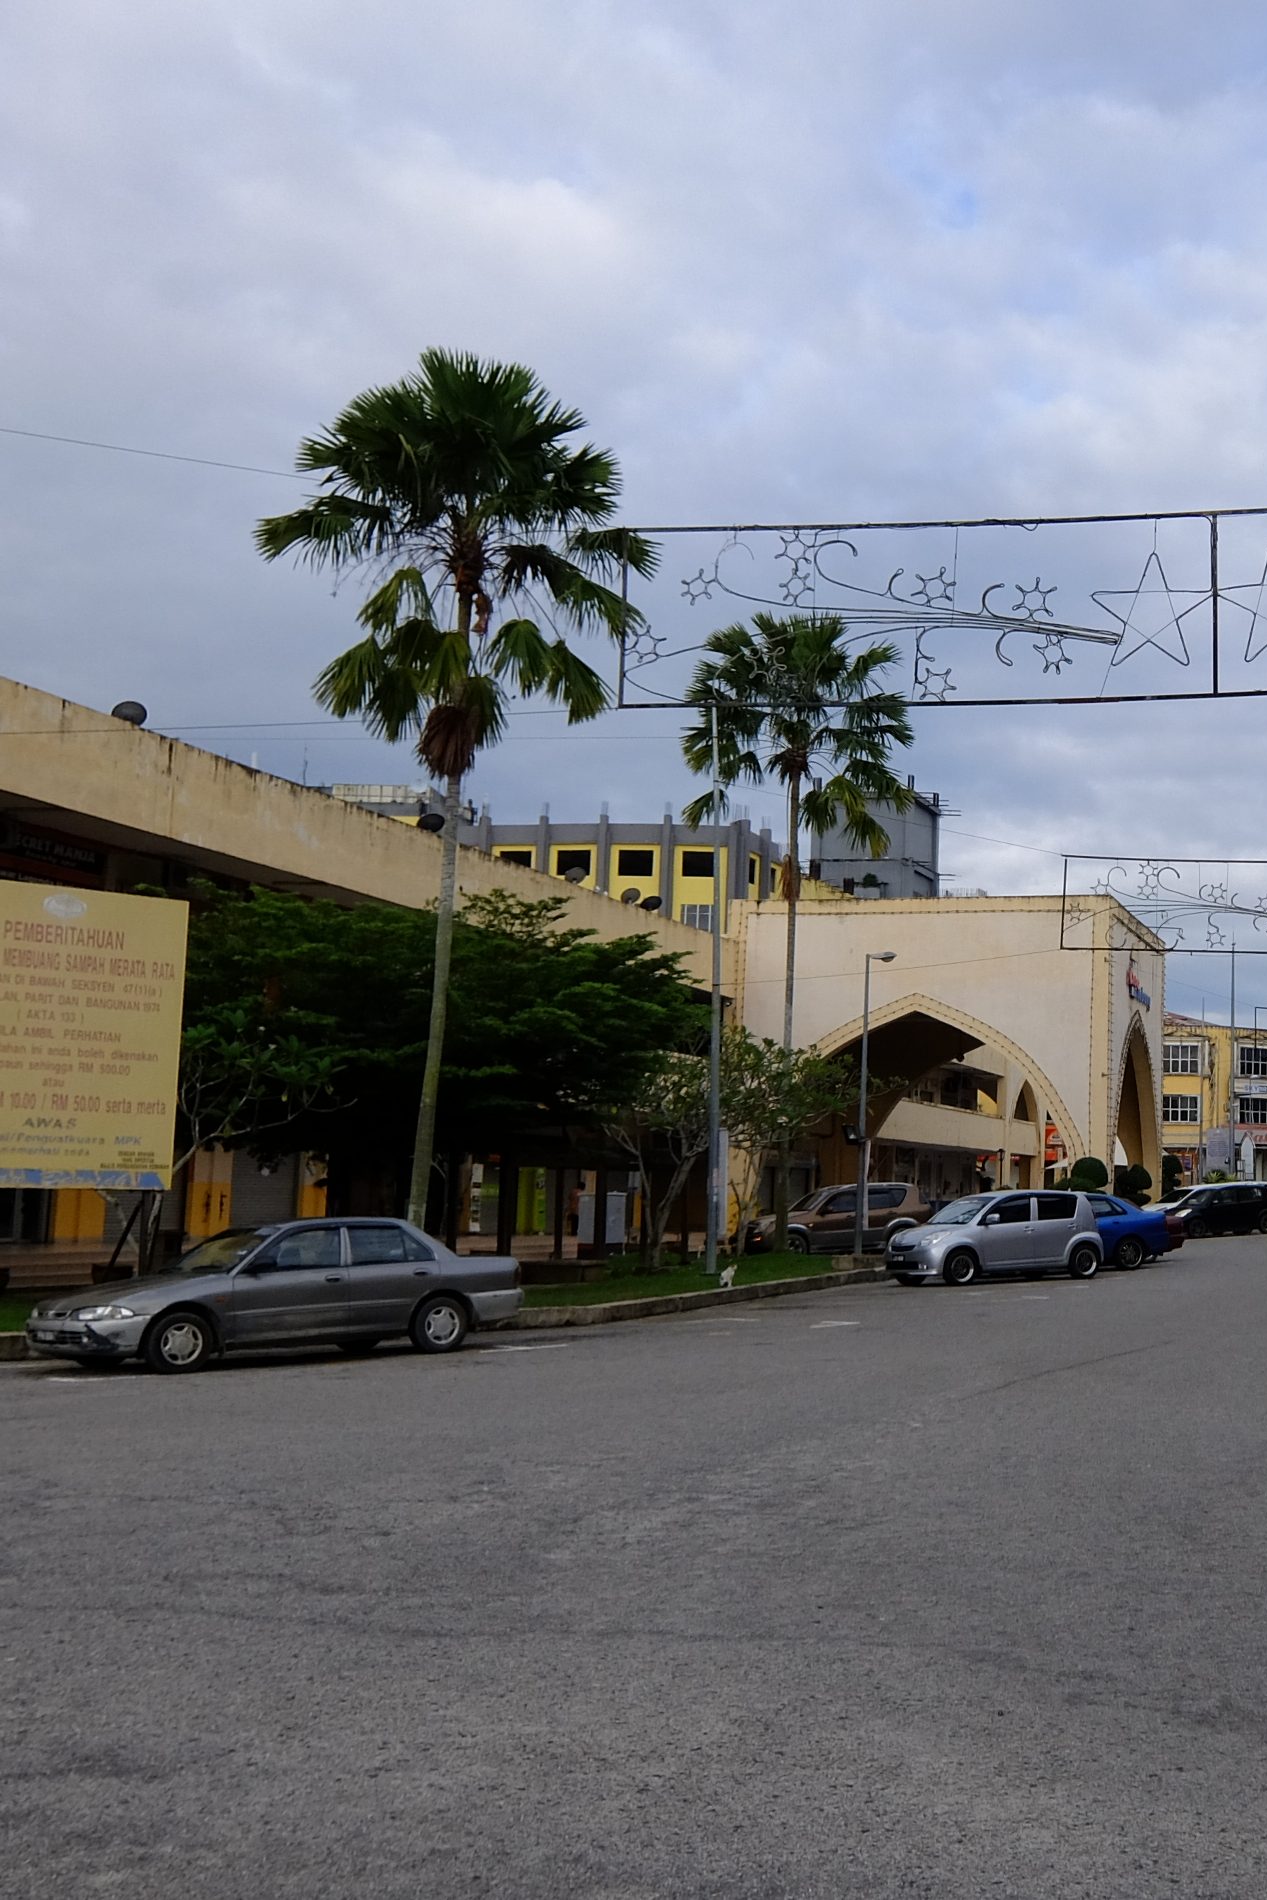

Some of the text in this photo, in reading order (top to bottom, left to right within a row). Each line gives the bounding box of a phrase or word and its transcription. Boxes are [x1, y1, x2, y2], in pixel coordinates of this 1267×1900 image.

[4, 919, 125, 950] PEMBERITAHUAN
[65, 953, 105, 976] SAMPAH
[110, 957, 146, 979] MERATA
[151, 961, 176, 982] RATA
[71, 979, 116, 993] SEKSYEN
[58, 994, 80, 1008] DAN
[27, 1008, 56, 1022] AKTA
[63, 1028, 122, 1044] PERHATIAN
[78, 1062, 94, 1074] RM
[52, 1093, 69, 1111] RM
[106, 1097, 132, 1114] serta
[137, 1098, 167, 1116] merta
[22, 1116, 78, 1130] AWAS
